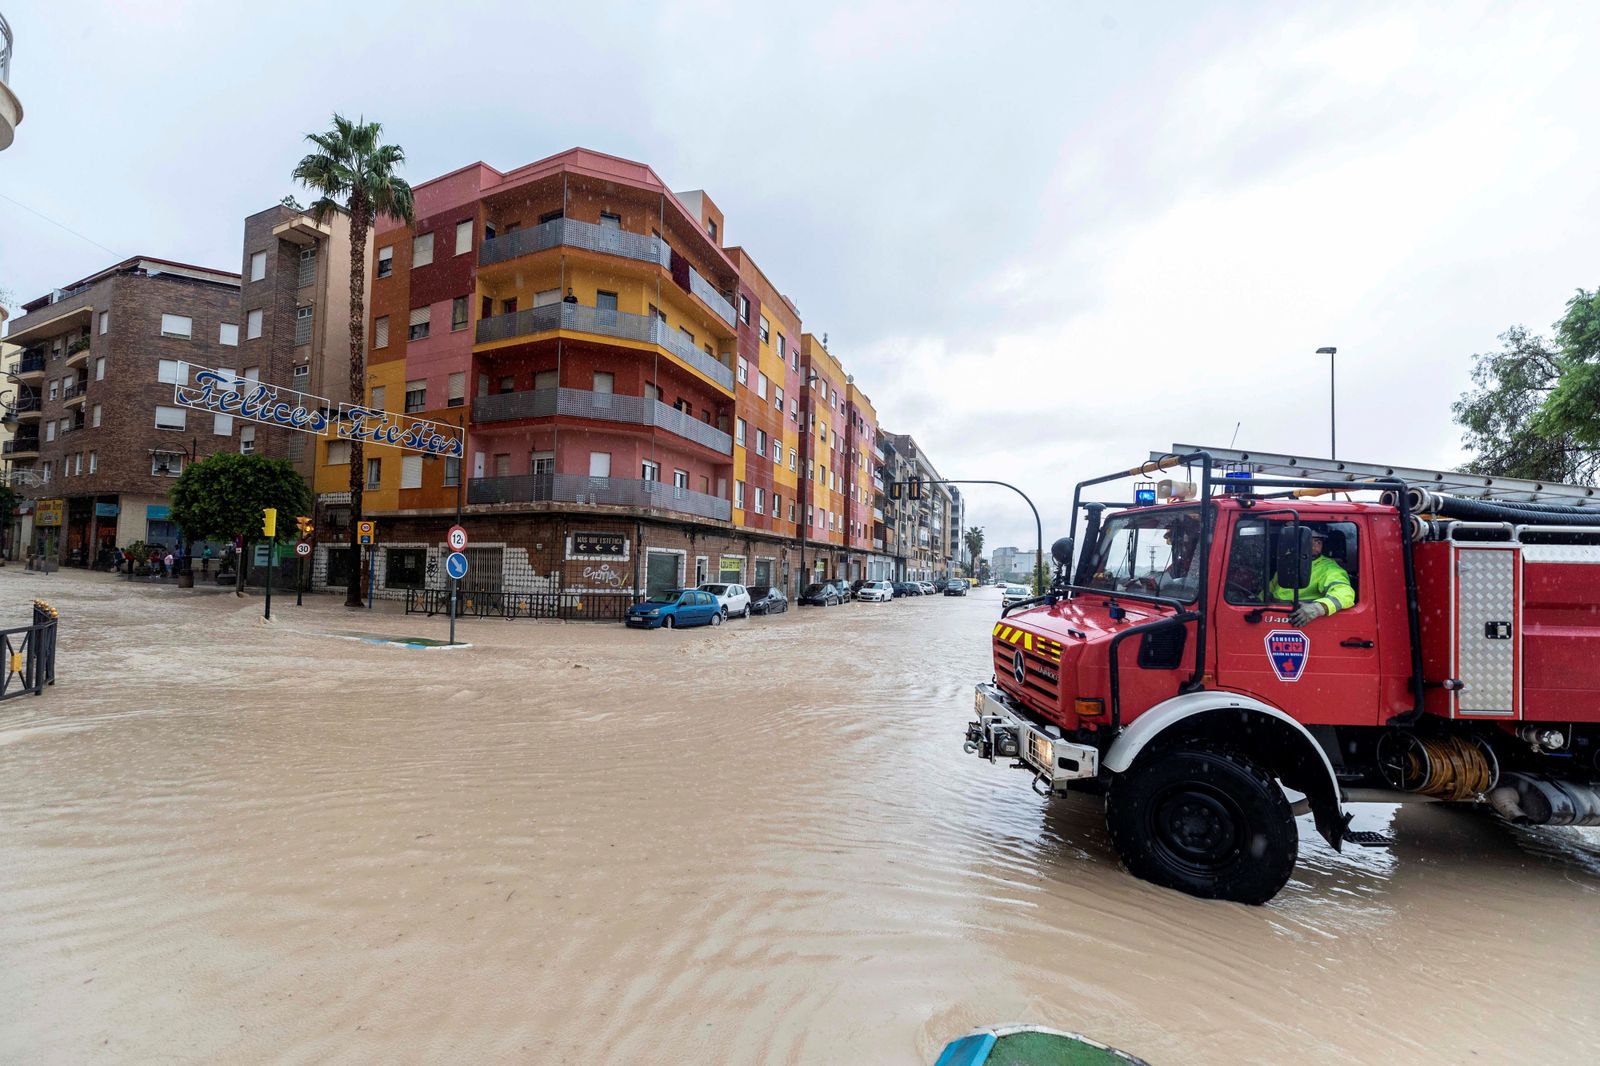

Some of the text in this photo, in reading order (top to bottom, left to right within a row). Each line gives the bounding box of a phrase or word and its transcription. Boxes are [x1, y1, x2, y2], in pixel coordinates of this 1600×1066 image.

[178, 370, 463, 455] Felices Fiestas
[588, 536, 598, 544] QUE
[298, 545, 309, 553] 30
